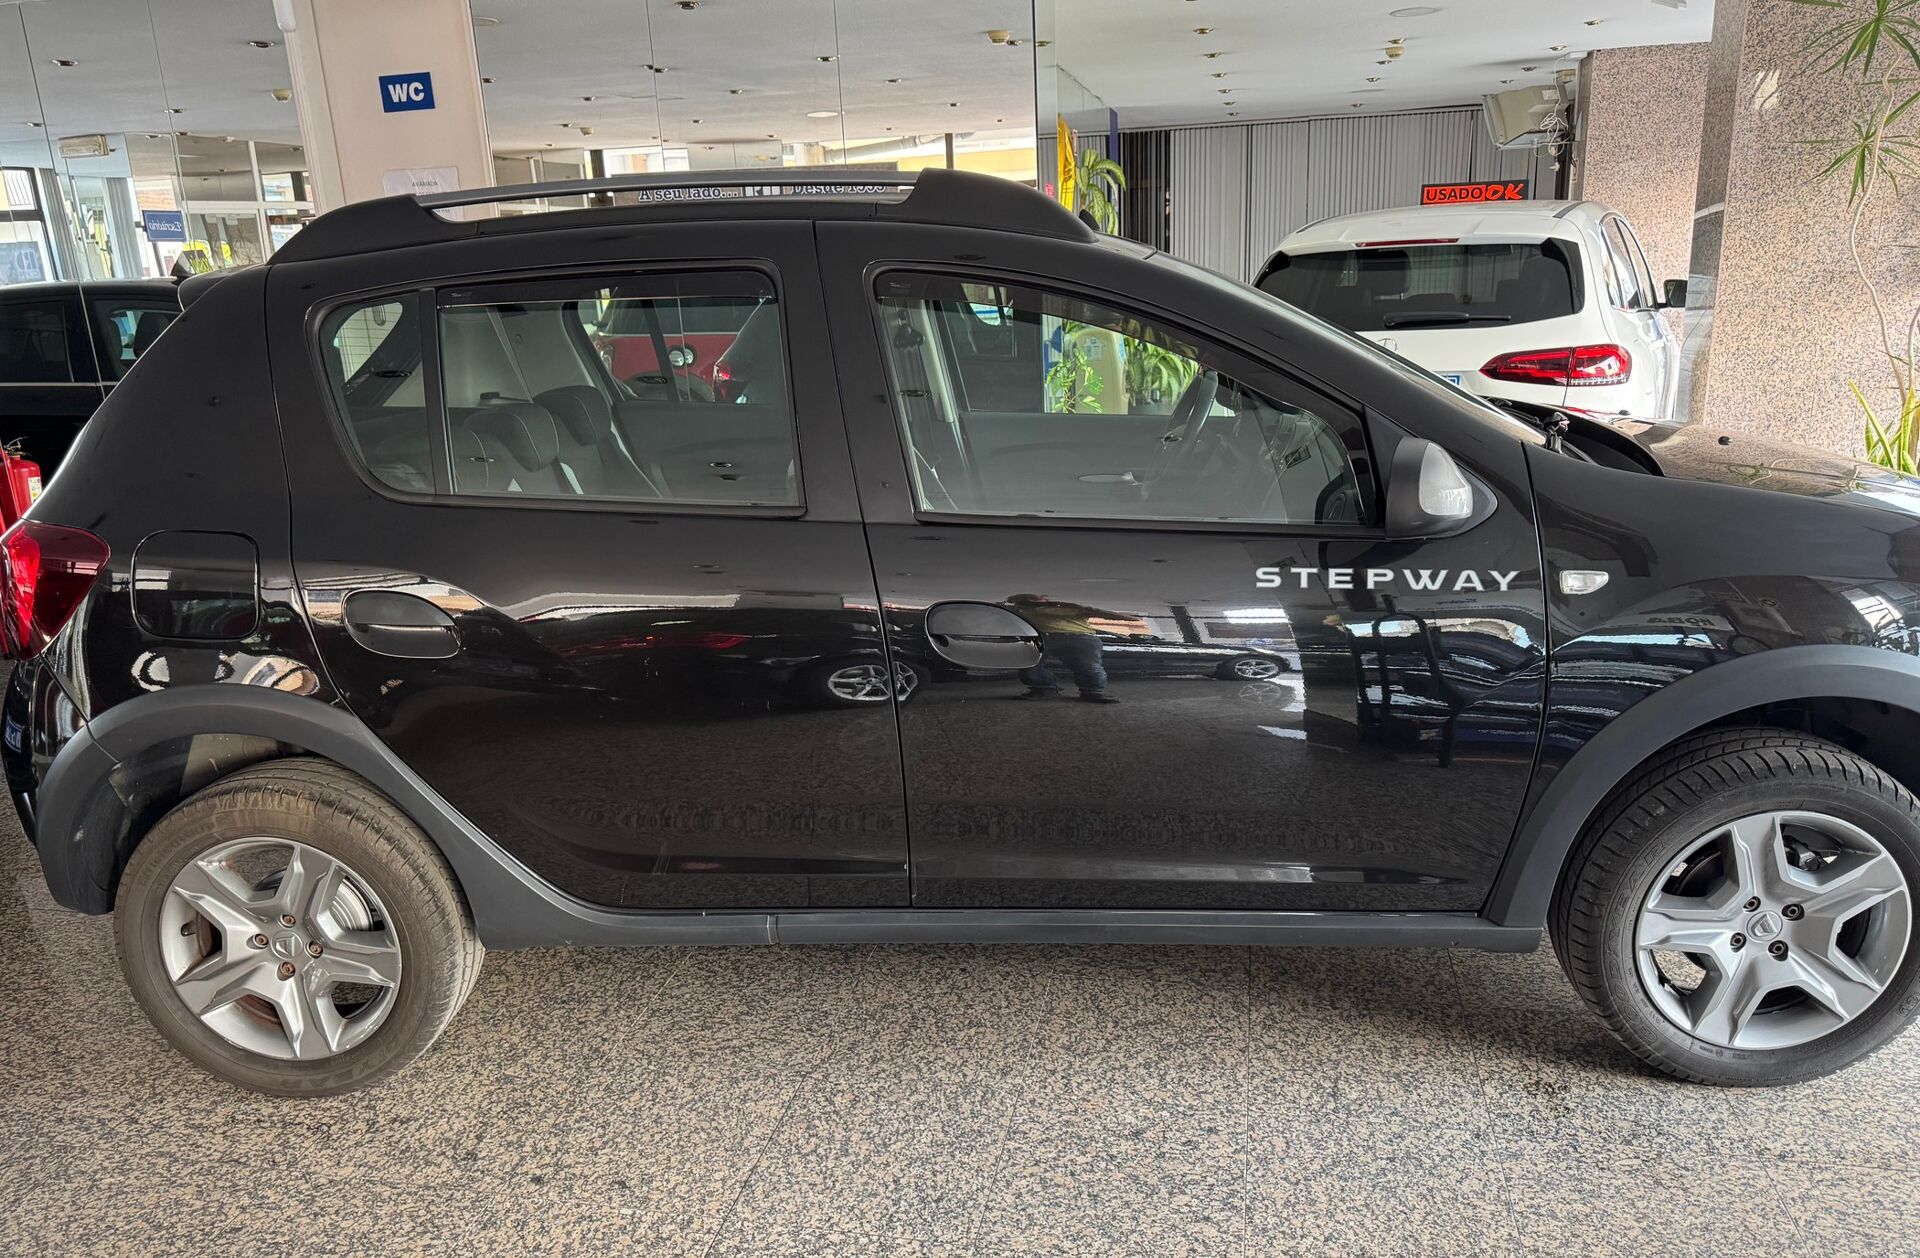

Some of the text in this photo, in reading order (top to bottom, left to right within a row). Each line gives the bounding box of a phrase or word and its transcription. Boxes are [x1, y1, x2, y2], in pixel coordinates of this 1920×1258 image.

[387, 82, 425, 103] WC
[639, 188, 652, 201] A
[655, 188, 683, 201] seu
[1426, 183, 1524, 201] USADO OK
[1255, 567, 1521, 592] STEPWAY
